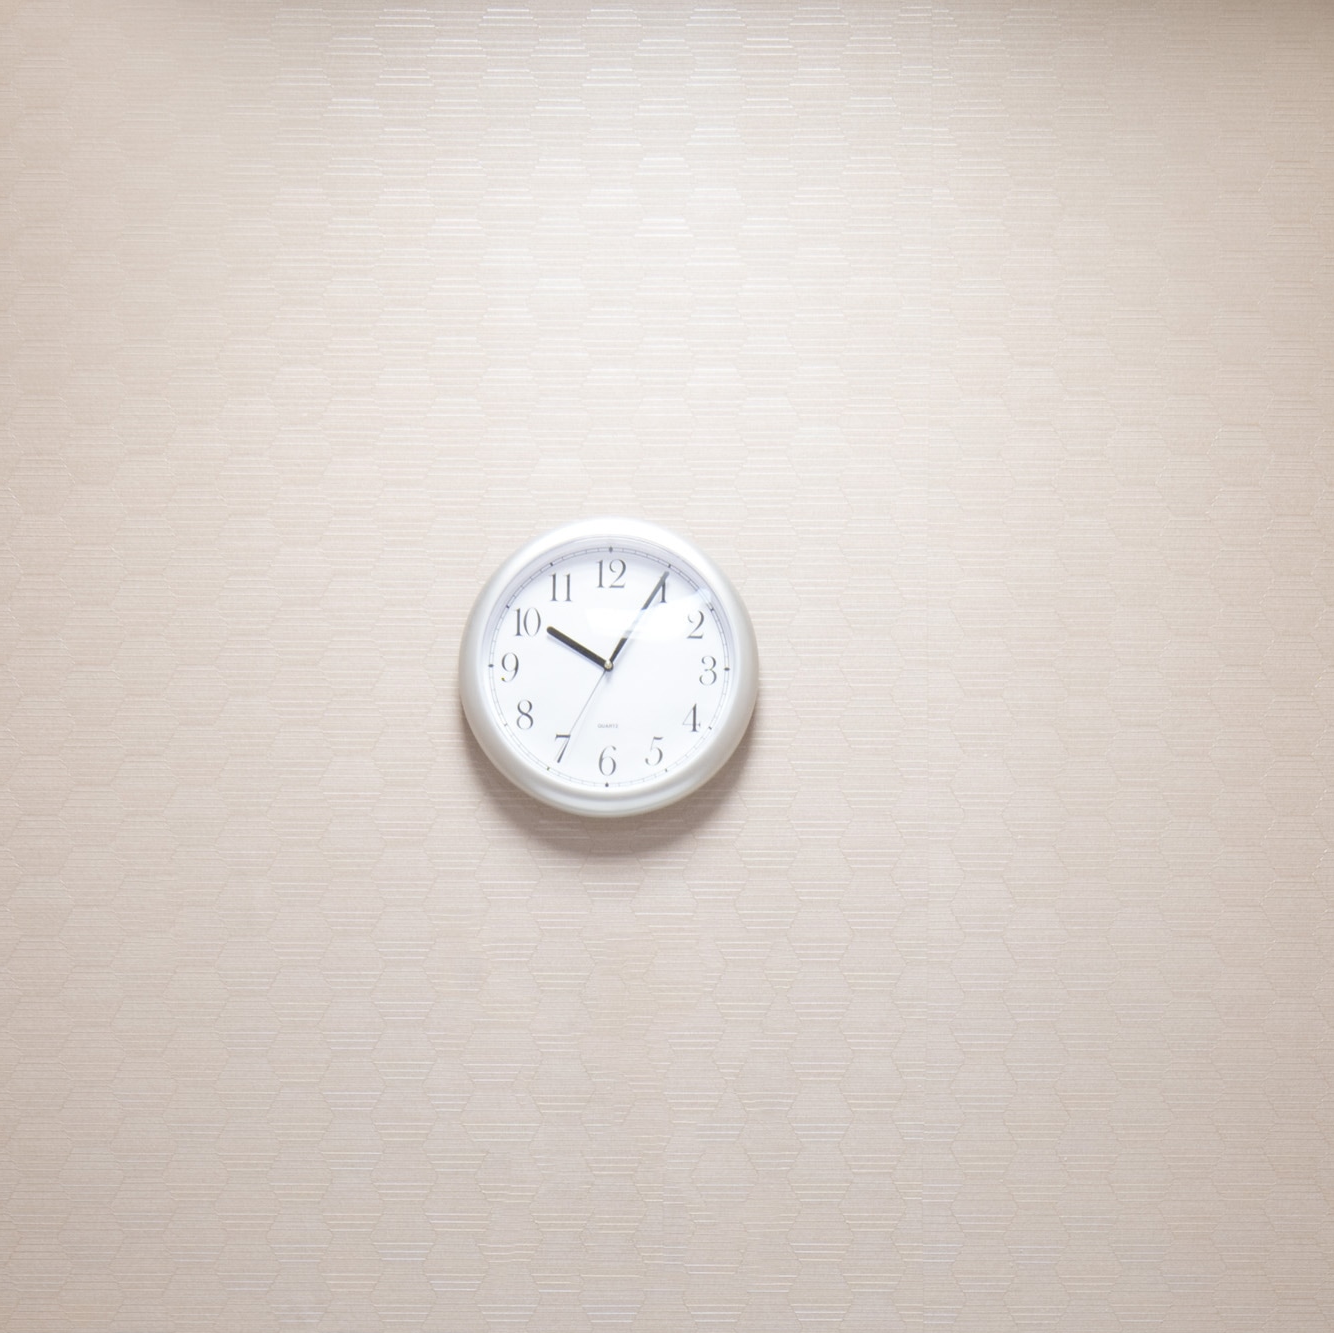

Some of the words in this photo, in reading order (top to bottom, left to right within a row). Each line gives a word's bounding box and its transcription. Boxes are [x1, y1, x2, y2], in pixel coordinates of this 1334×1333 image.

[550, 572, 573, 602] 11
[596, 559, 626, 588] 12
[515, 607, 541, 637] 10
[686, 610, 705, 639] 2
[501, 652, 520, 682] 9
[699, 655, 717, 685] 3
[516, 700, 534, 730] 8
[682, 703, 701, 732] 4
[555, 734, 571, 764] 7
[598, 745, 617, 776] 6
[645, 736, 663, 766] 5
